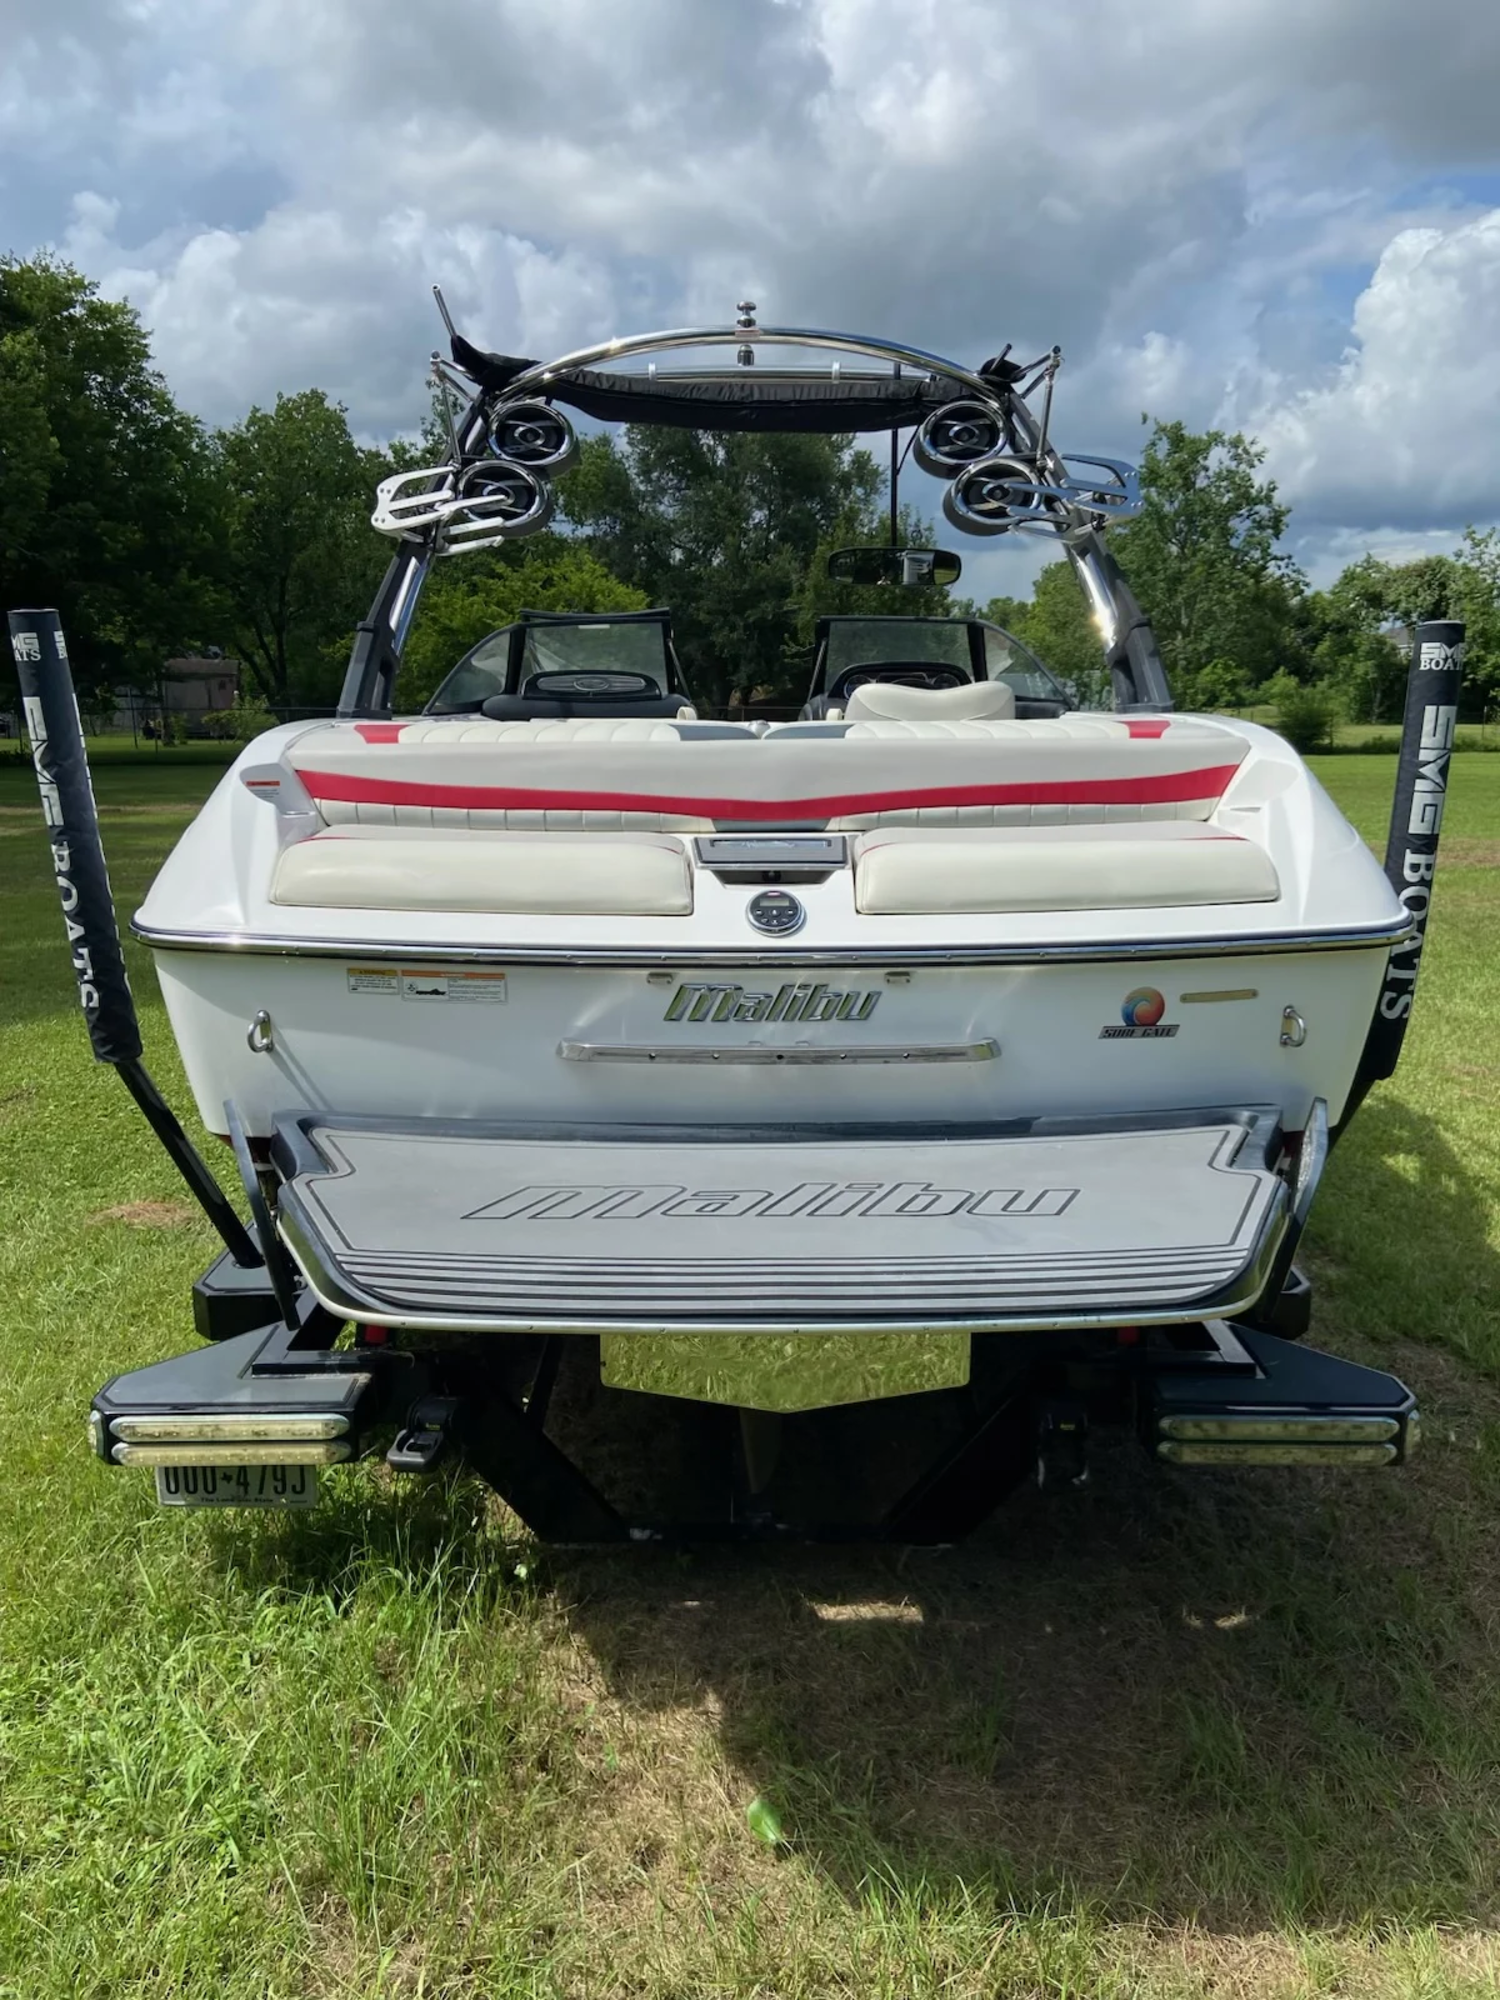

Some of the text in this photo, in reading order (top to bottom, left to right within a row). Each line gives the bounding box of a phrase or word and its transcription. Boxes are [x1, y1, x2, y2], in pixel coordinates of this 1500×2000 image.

[1419, 658, 1462, 671] BOAT
[1408, 705, 1457, 835] SMG
[663, 983, 883, 1022] Malibu
